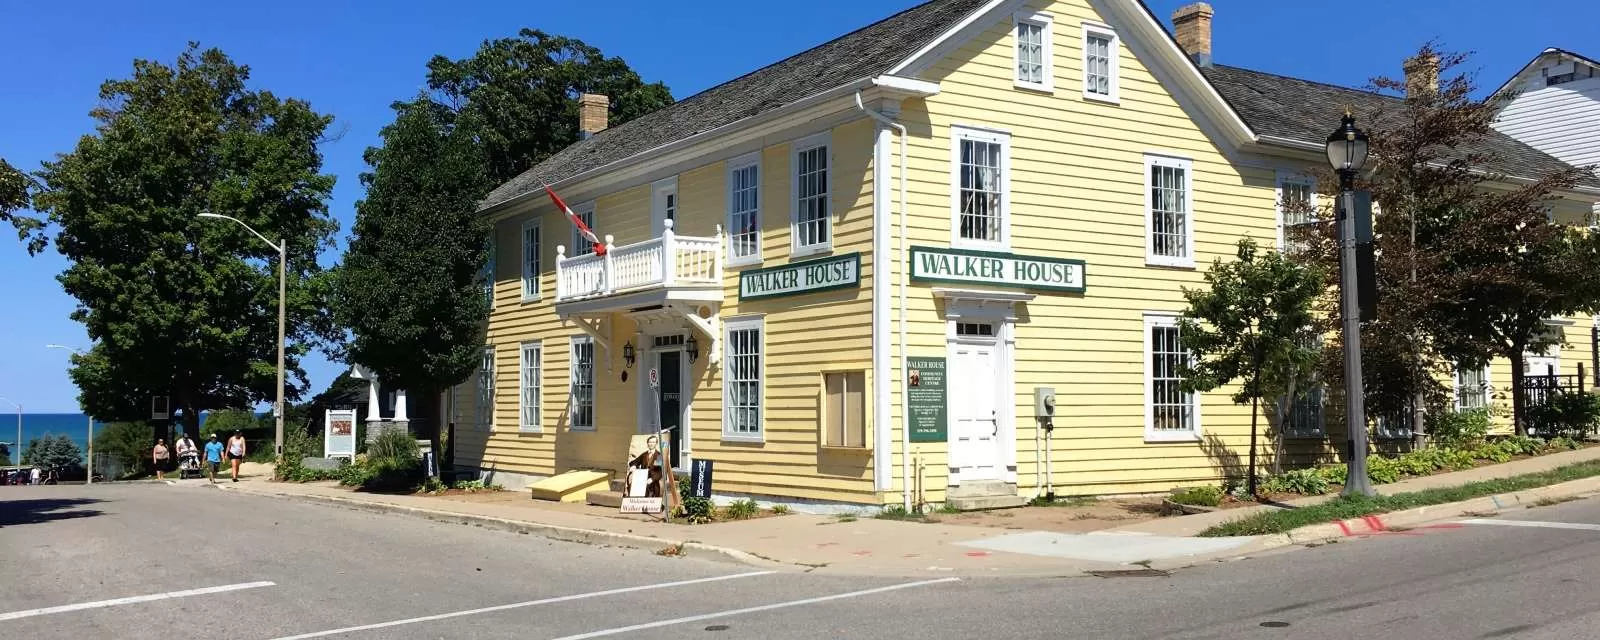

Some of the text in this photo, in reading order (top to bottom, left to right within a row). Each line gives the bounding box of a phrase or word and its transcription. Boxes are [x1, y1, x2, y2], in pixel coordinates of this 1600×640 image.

[745, 261, 850, 295] WALKER HOUSE
[921, 253, 1074, 284] WALKER HOUSE
[696, 460, 706, 497] MUSEUM
